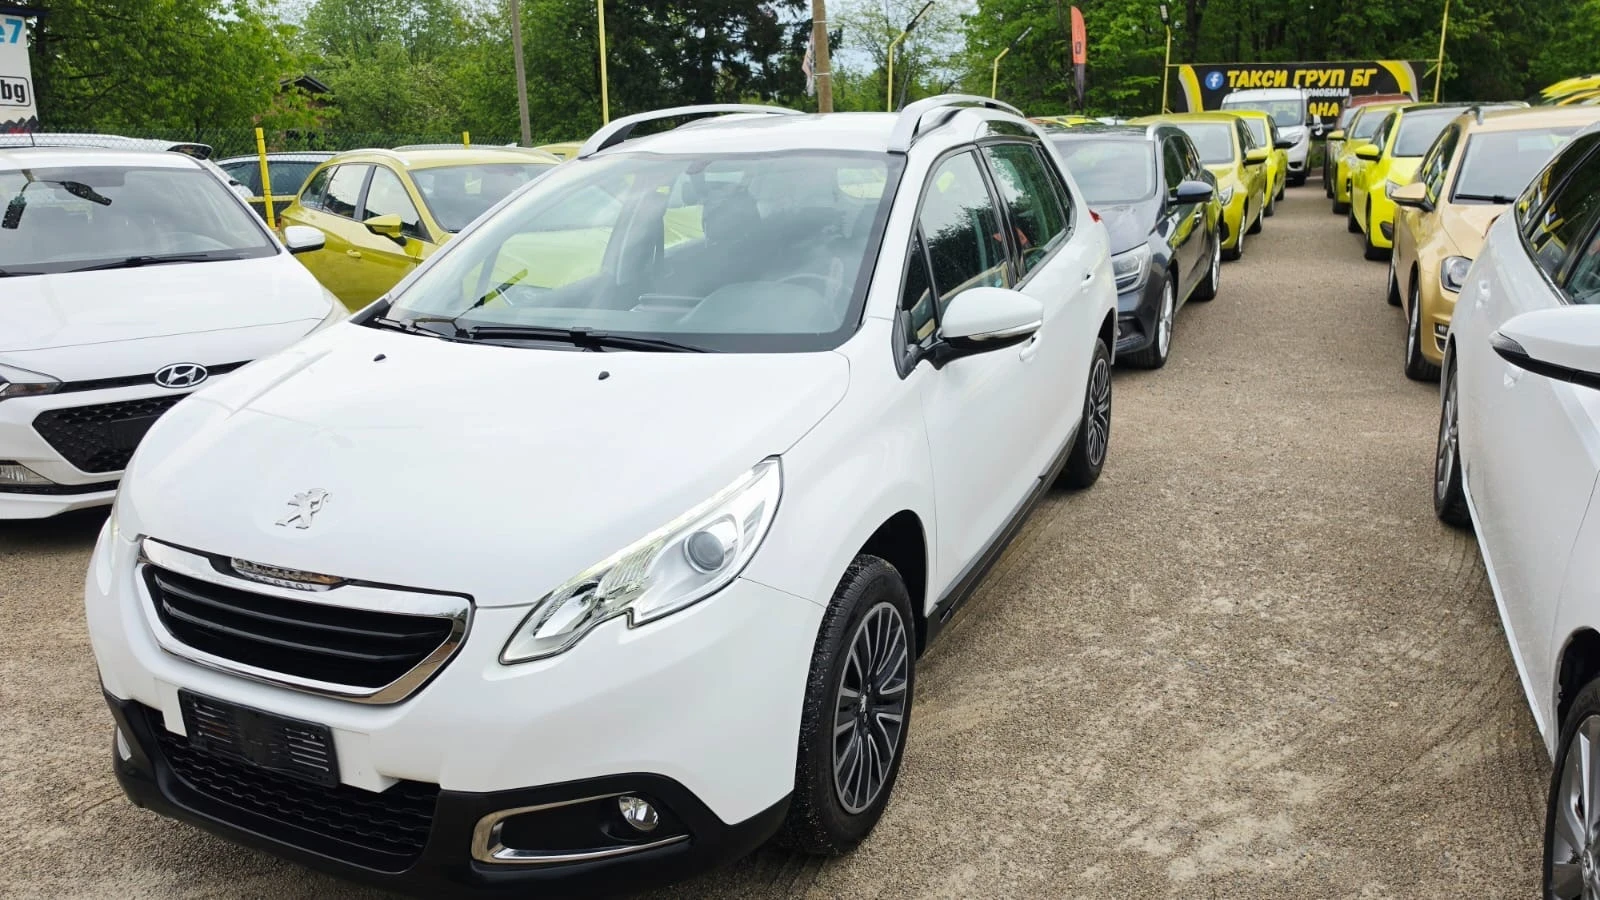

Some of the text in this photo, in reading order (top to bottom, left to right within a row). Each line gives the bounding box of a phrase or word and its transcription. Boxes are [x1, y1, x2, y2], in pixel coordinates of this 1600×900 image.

[1227, 68, 1378, 88] ТАКСИ ГРУП БГ
